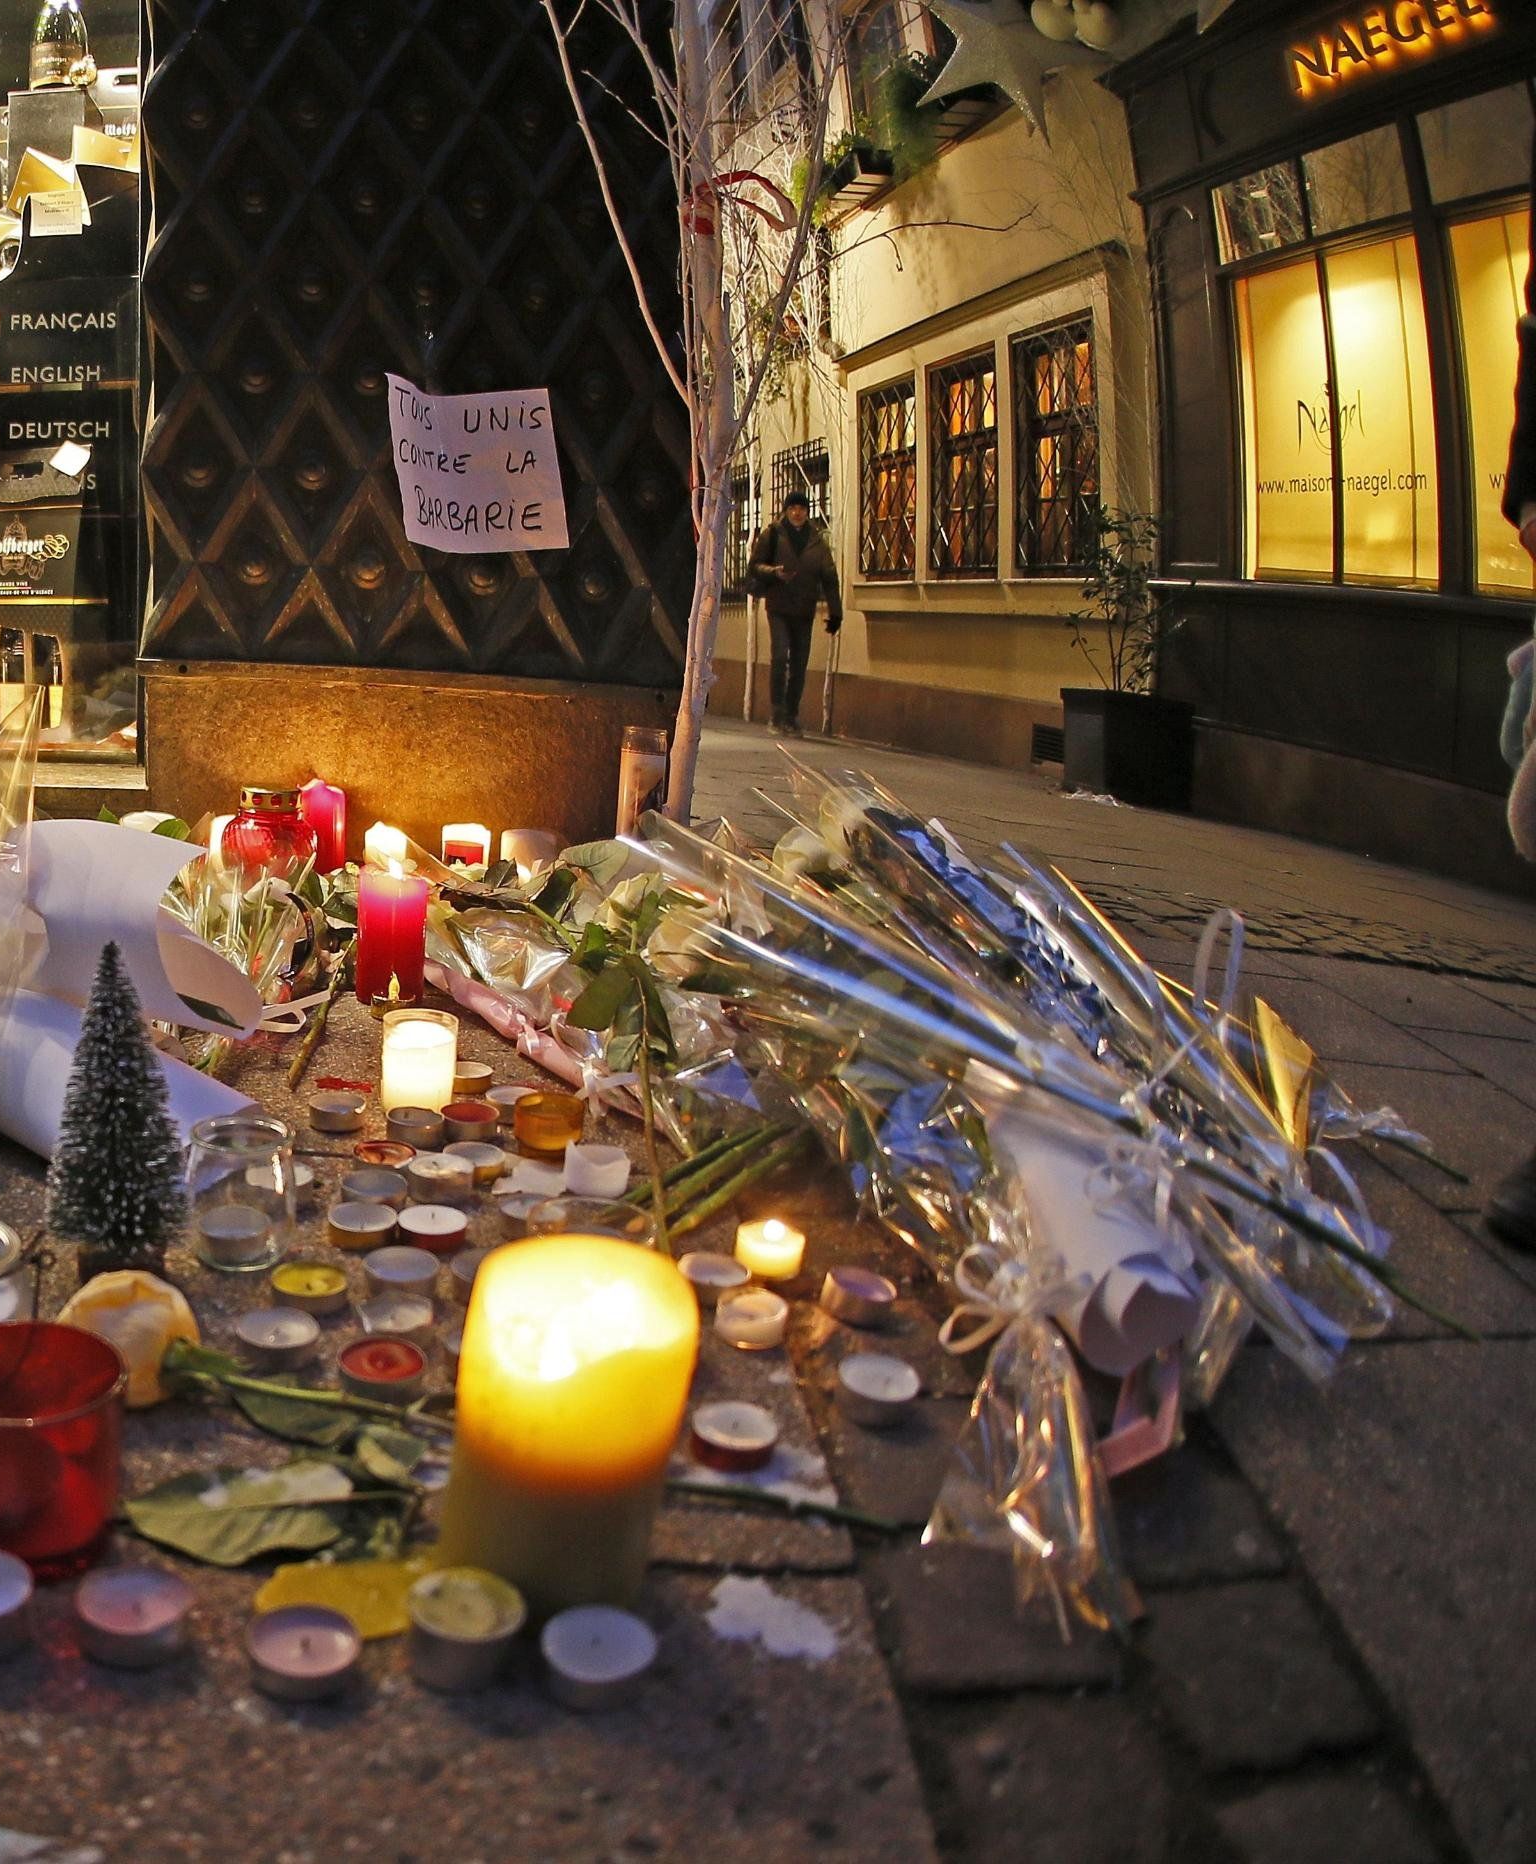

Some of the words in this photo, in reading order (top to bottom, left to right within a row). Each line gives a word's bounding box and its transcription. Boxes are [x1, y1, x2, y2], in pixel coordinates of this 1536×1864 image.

[10, 312, 117, 332] FRANÇAIS
[10, 365, 101, 384] ENGLISH
[9, 421, 110, 440] DEUTSCH
[399, 438, 472, 474] CONTRE
[505, 450, 537, 474] LA
[415, 485, 543, 535] BARBARIE
